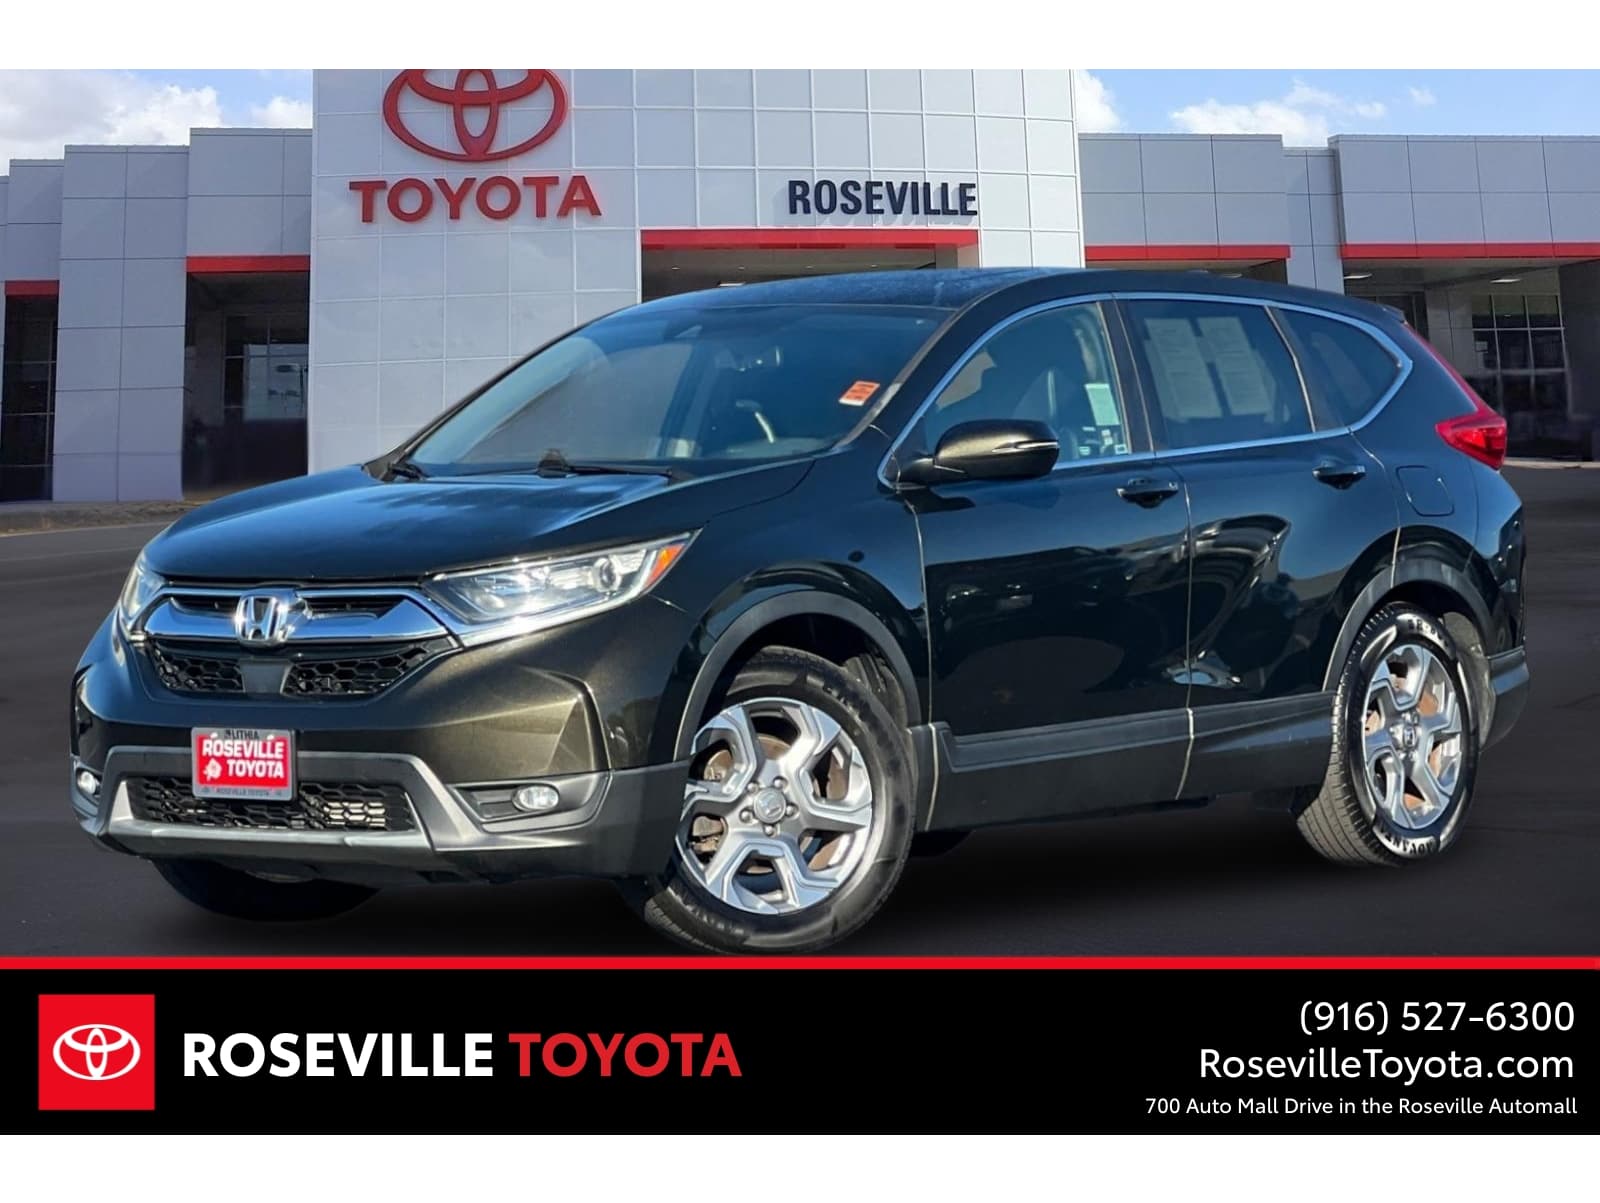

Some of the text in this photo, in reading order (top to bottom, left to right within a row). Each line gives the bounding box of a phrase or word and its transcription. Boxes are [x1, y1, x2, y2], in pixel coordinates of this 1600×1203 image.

[349, 175, 602, 223] TOYOTA
[788, 180, 978, 216] ROSEVILLE
[202, 739, 284, 759] ROSEVILLE
[226, 759, 284, 778] TOYOTA
